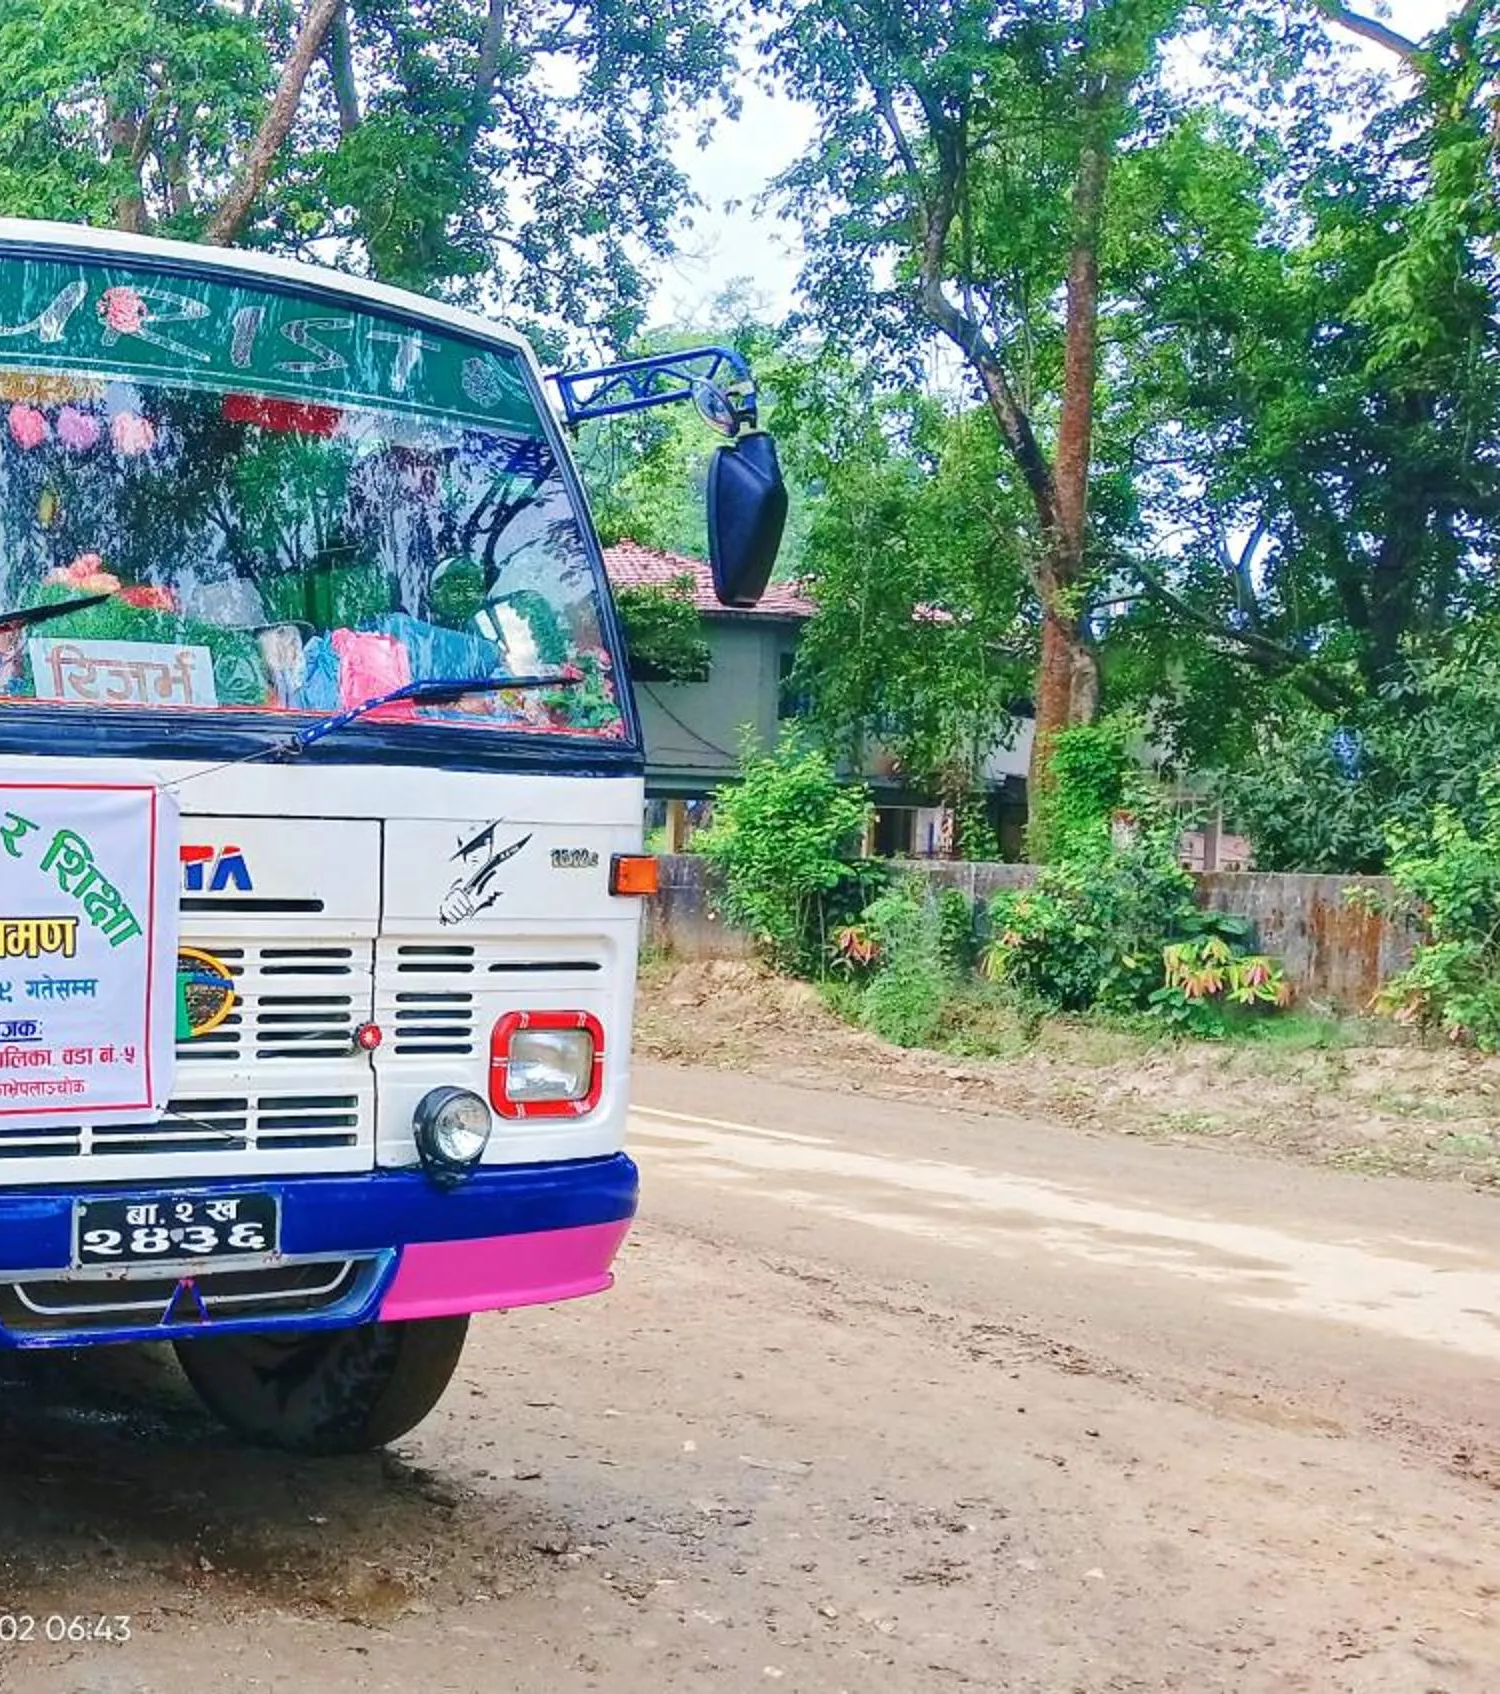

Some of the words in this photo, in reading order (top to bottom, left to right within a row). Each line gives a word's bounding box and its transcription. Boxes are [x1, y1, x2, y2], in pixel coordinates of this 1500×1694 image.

[0, 811, 40, 858] र
[40, 829, 143, 947] शिक्षा
[179, 845, 252, 891] TA
[175, 1202, 194, 1223] २
[205, 1199, 241, 1222] ख
[82, 1222, 267, 1256] २४३६
